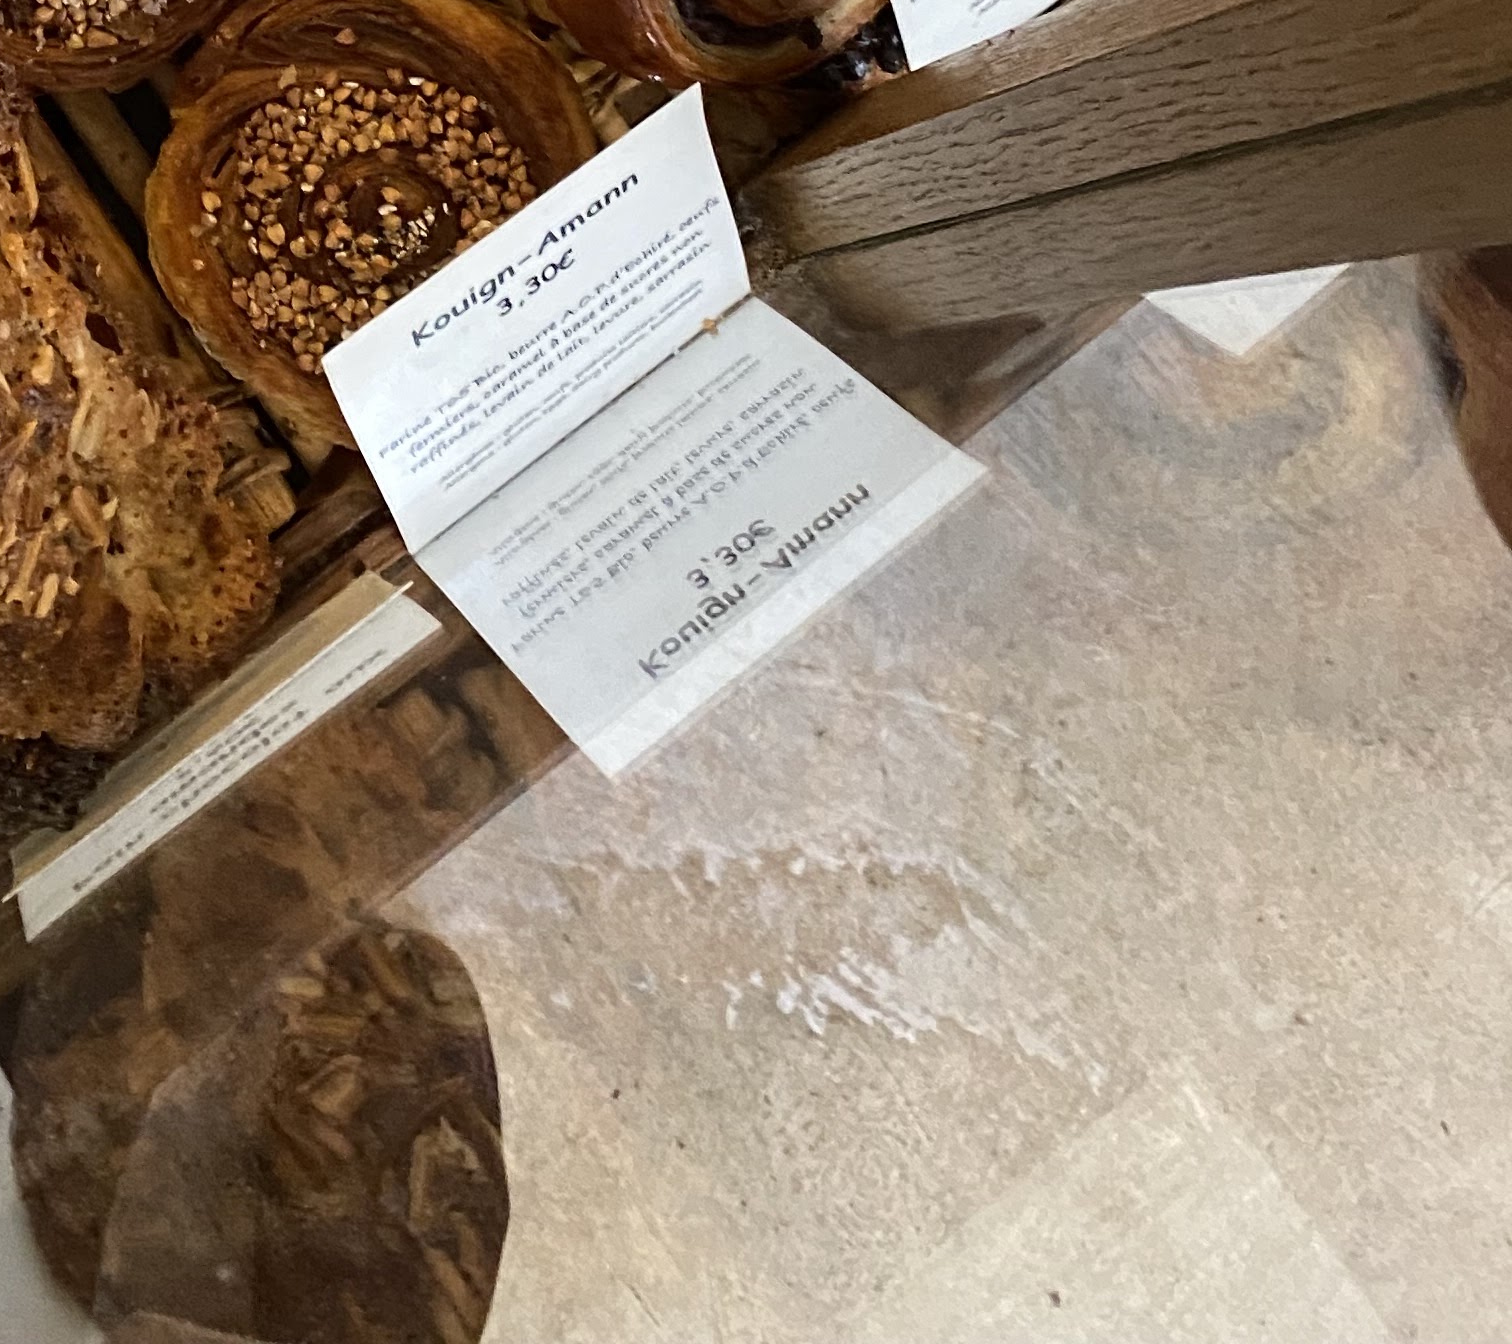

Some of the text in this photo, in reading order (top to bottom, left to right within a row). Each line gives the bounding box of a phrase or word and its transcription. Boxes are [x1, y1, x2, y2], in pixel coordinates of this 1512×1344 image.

[411, 173, 638, 347] Kouign-Amann
[496, 248, 574, 316] 3,30€
[599, 294, 616, 311] de
[537, 360, 554, 378] de
